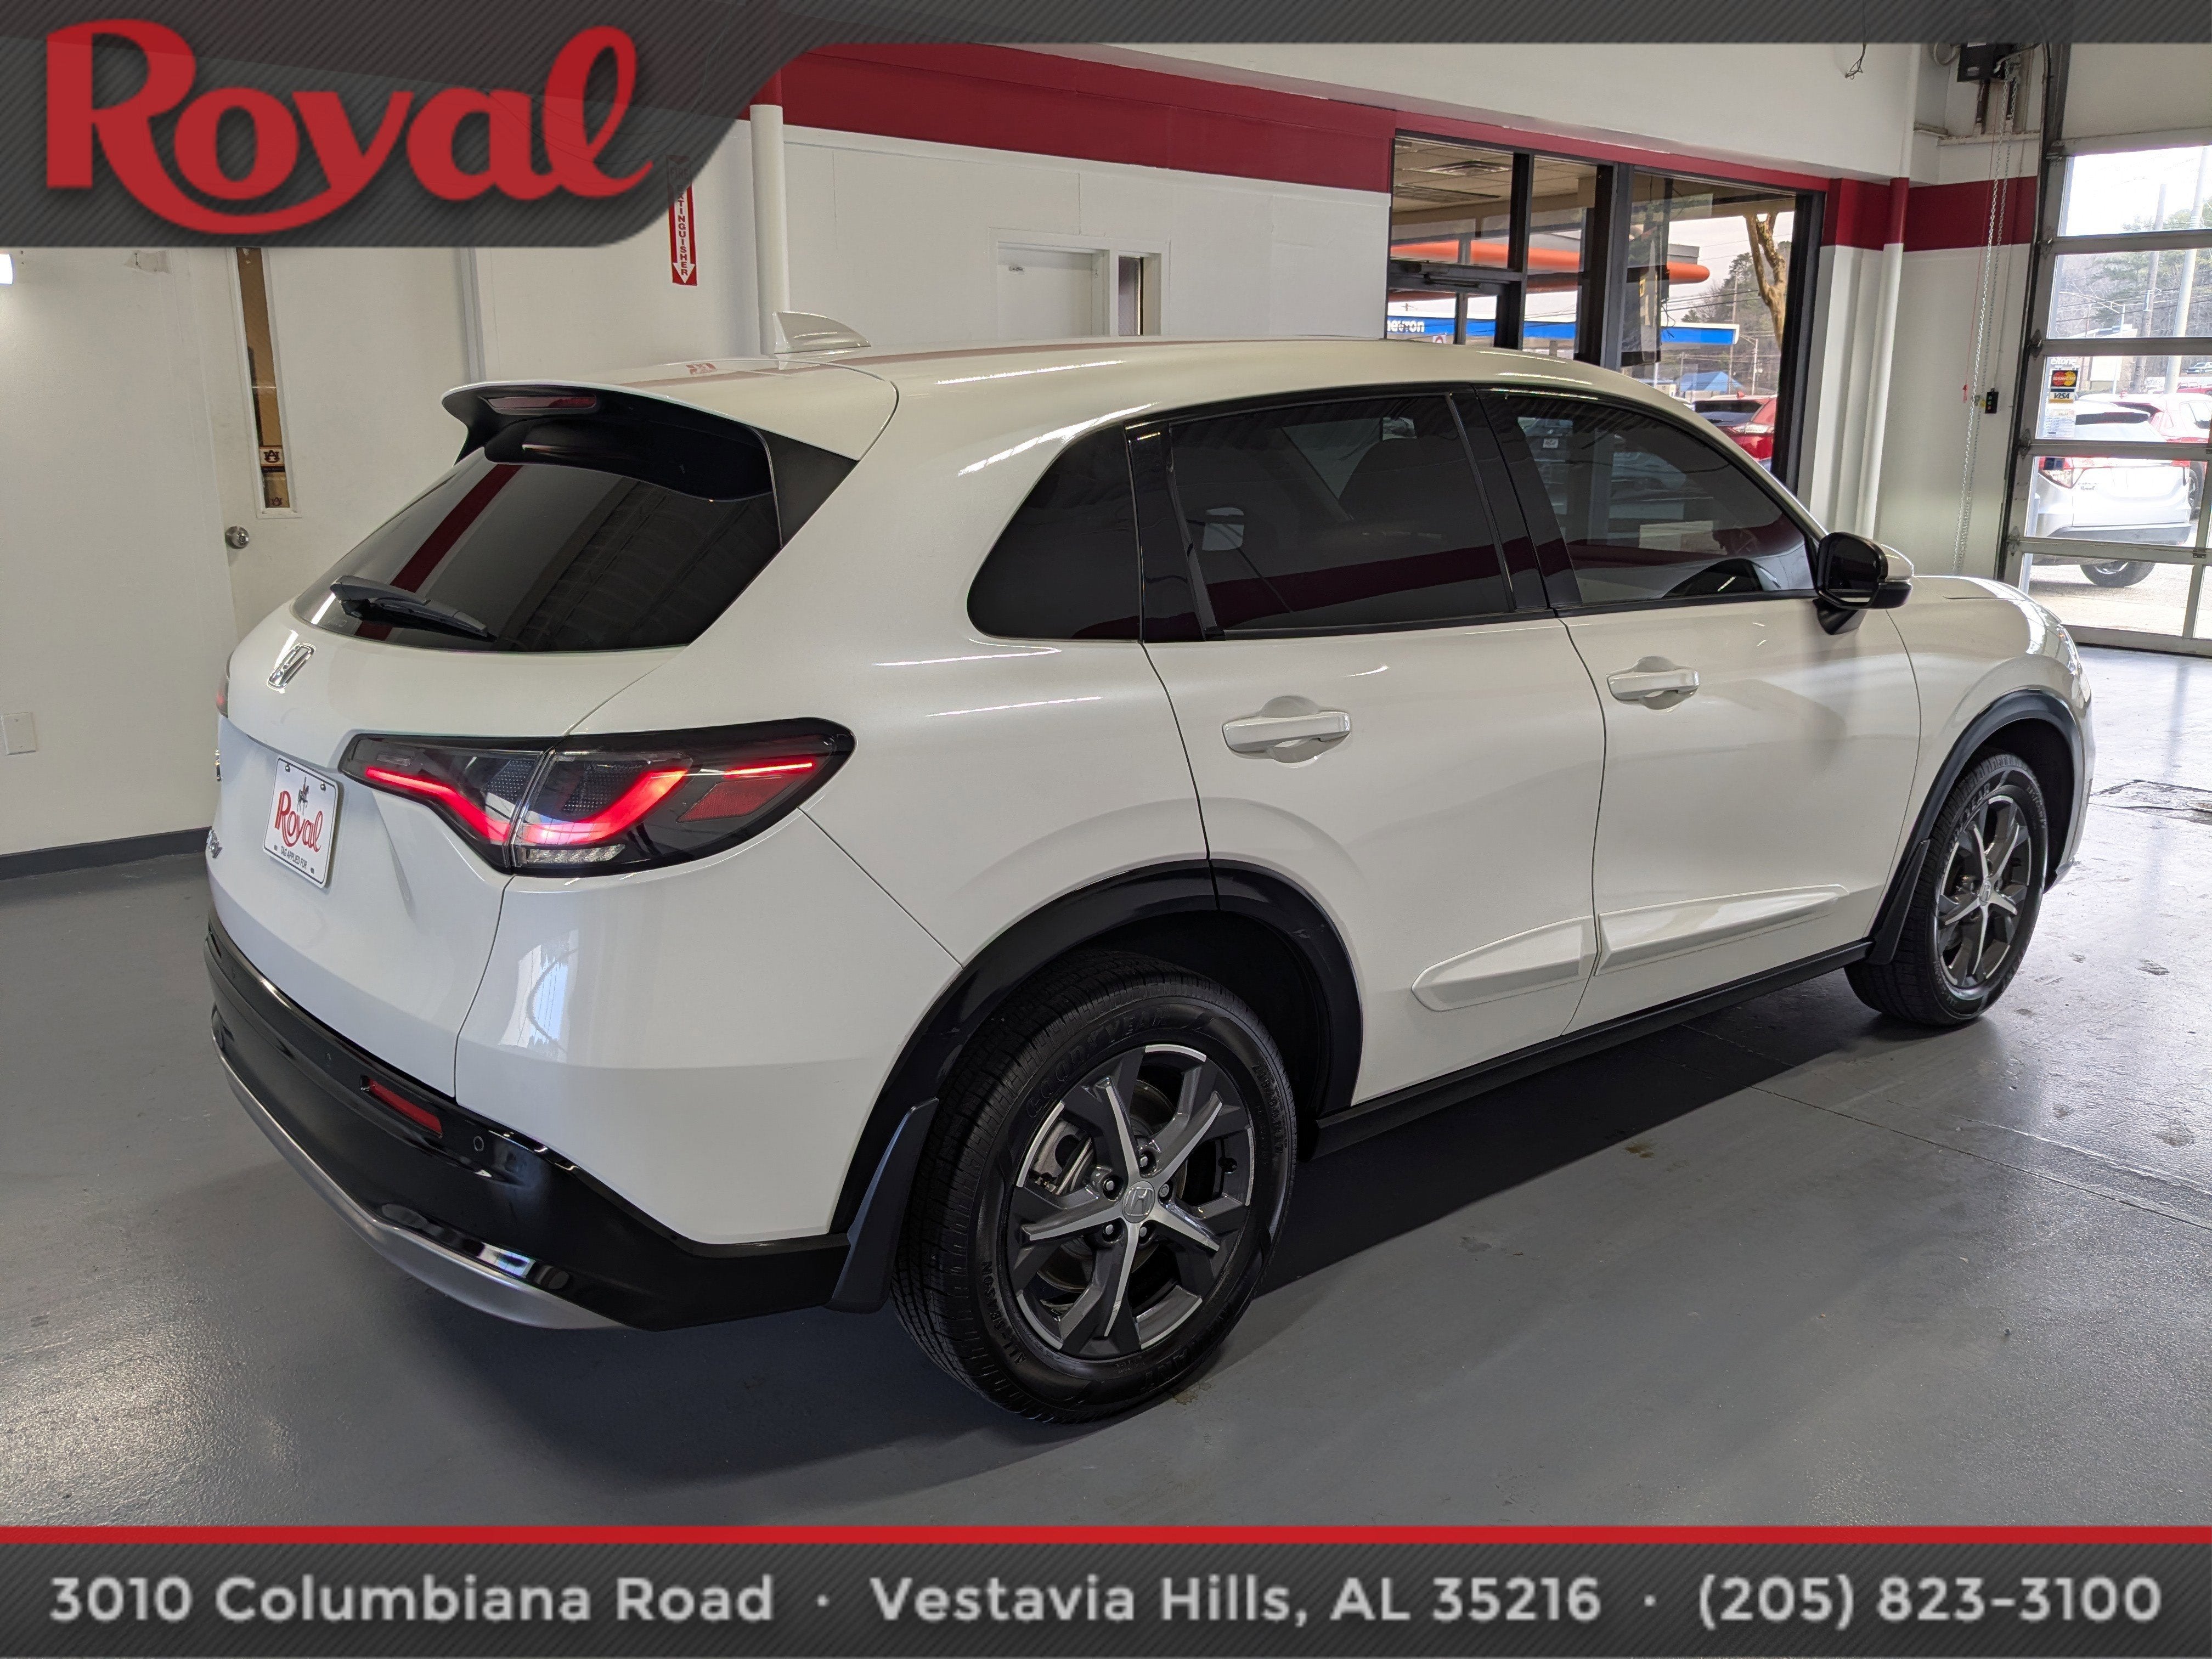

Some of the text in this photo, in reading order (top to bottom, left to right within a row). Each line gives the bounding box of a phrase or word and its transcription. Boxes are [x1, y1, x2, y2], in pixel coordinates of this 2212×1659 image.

[274, 790, 323, 853] Royal
[286, 850, 300, 865] APPLIED
[980, 1260, 1027, 1365] ALL-SEASON
